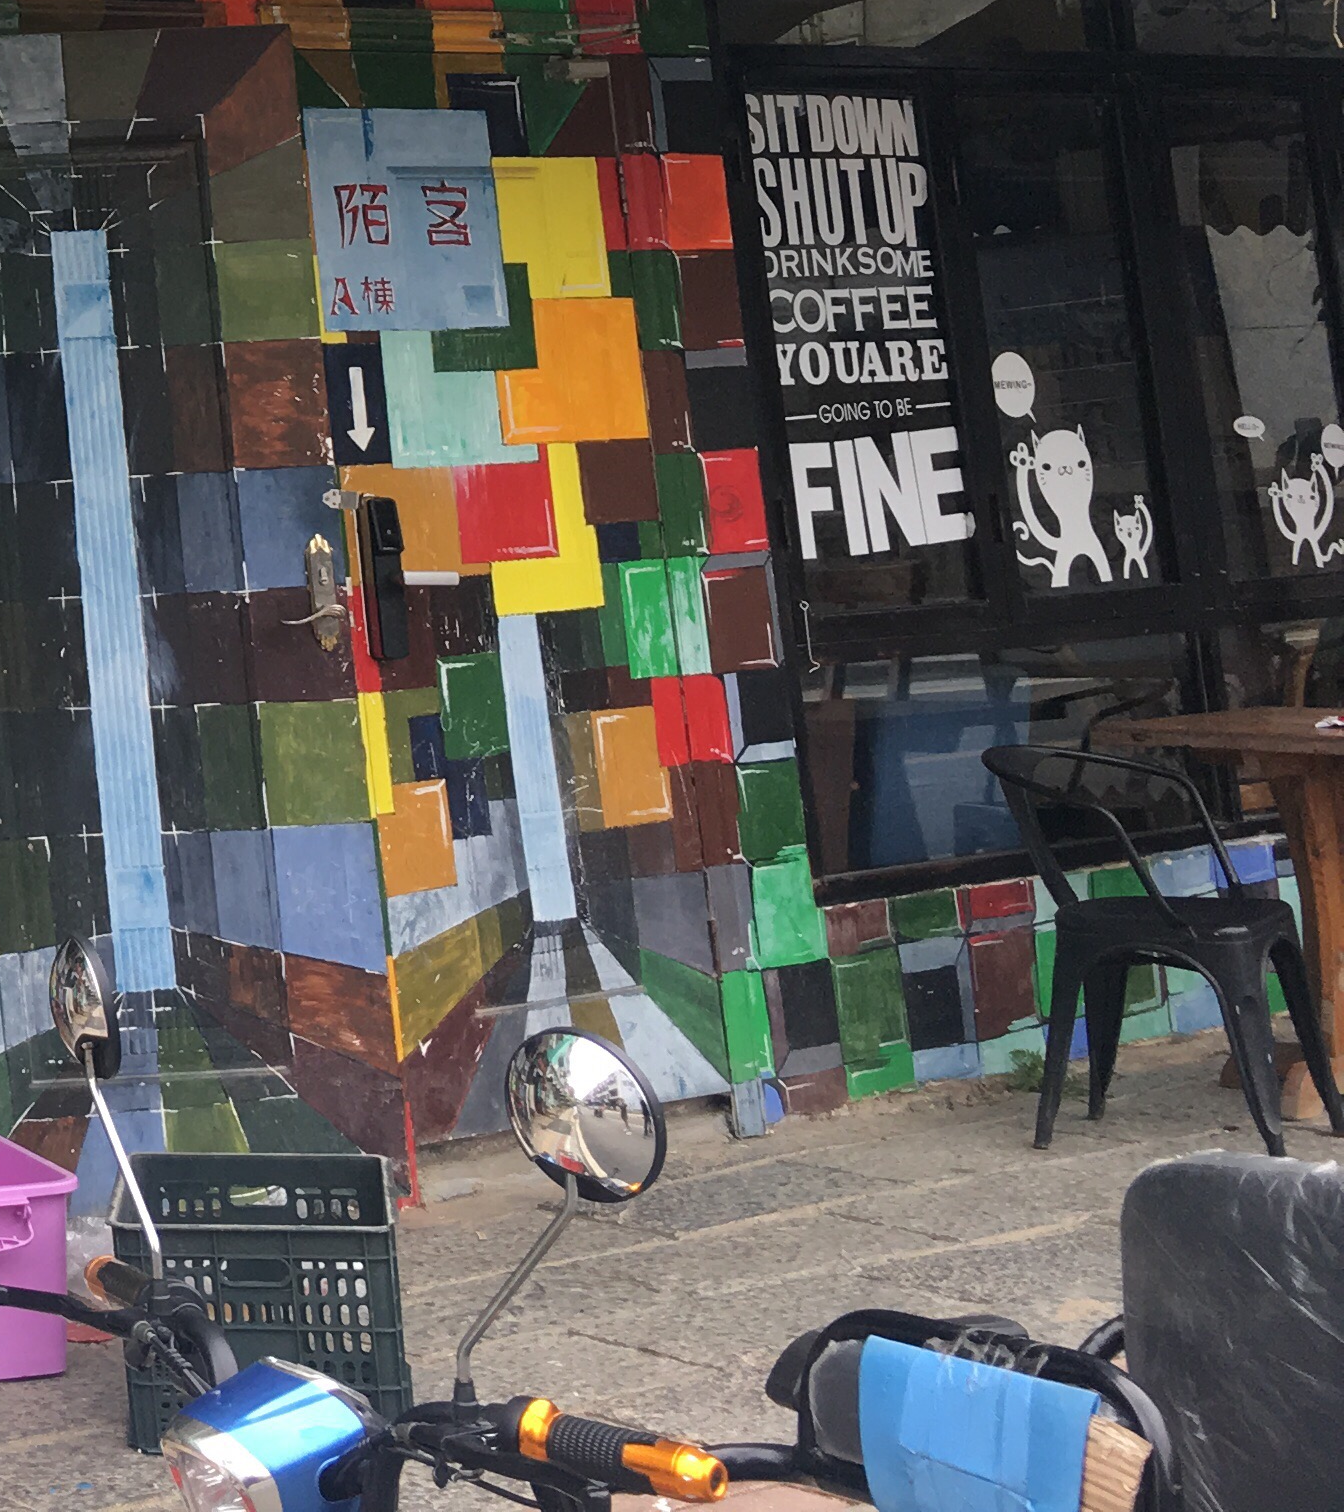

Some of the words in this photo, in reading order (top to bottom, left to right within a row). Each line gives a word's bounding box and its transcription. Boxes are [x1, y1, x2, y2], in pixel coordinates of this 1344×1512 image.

[744, 93, 804, 155] SIT
[810, 94, 920, 157] DOWN
[332, 178, 472, 249] 陌客
[752, 157, 868, 249] SHUT
[871, 158, 928, 249] UP
[768, 284, 939, 334] COFFEE
[818, 401, 871, 424] GOING
[873, 399, 893, 420] TO
[895, 397, 914, 418] BE
[788, 426, 976, 561] FINE
